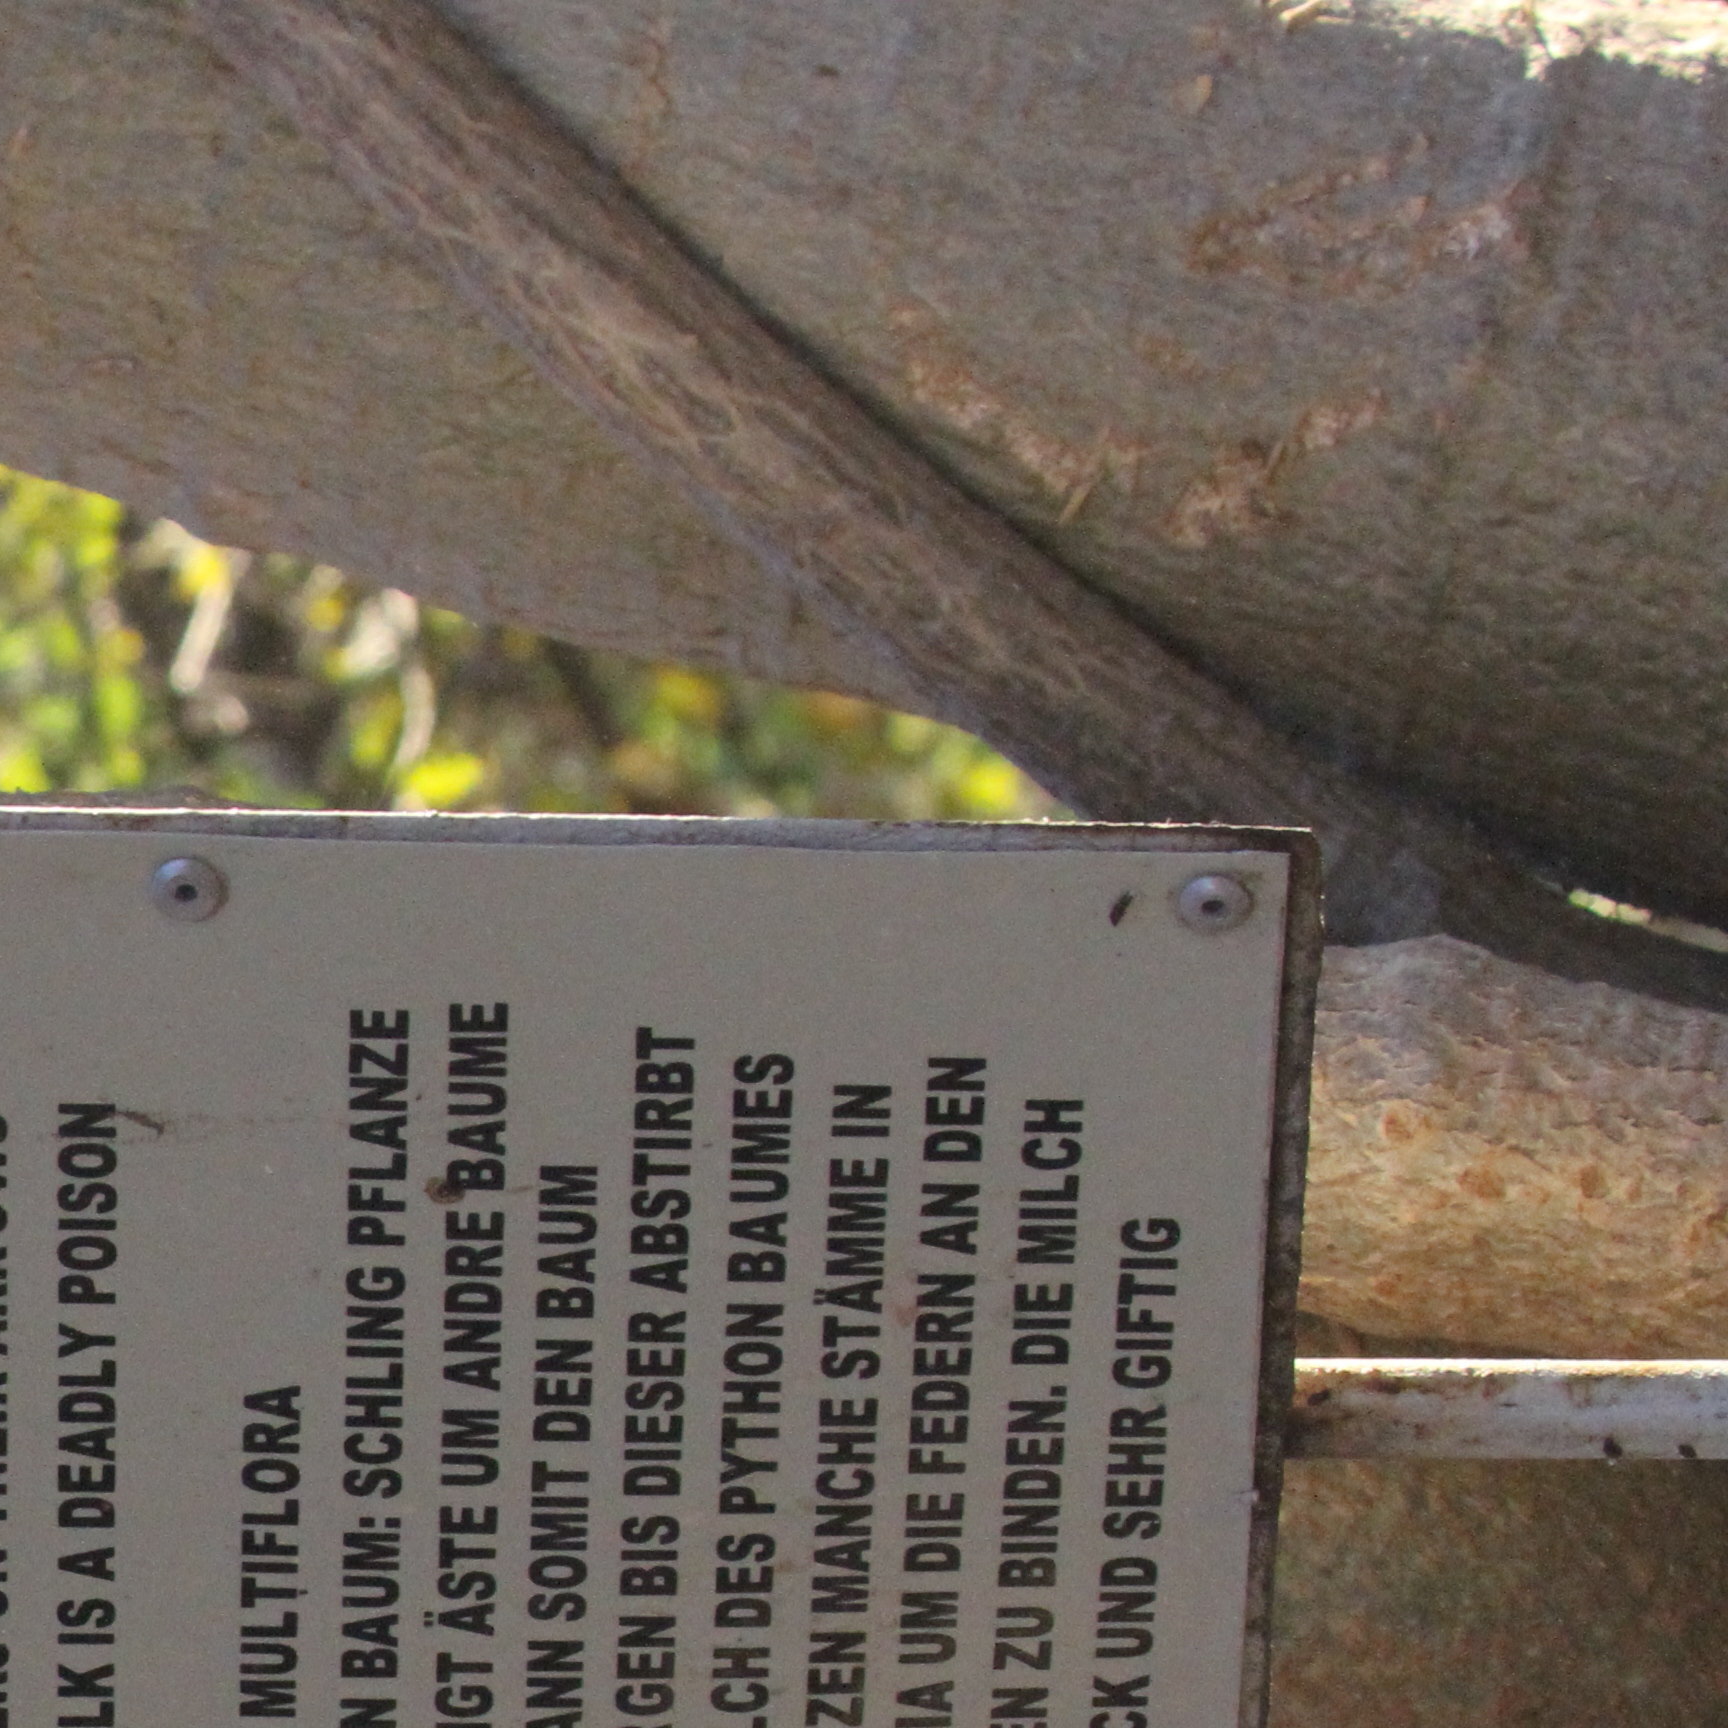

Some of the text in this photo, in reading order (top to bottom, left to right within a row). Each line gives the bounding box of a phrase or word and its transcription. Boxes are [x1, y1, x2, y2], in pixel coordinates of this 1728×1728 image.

[347, 1009, 410, 1247] PFLANZE
[446, 1002, 509, 1199] BAUME
[630, 1026, 695, 1293] ABSTIRBT
[727, 1053, 795, 1283] BAUMES
[831, 1084, 892, 1138] IN
[923, 1057, 987, 1162] DEN
[57, 1103, 118, 1305] POISON
[536, 1165, 598, 1319] BAUM
[920, 1183, 980, 1255] AN
[1016, 1099, 1084, 1264] MILCH
[443, 1211, 504, 1391] ANDRE
[814, 1158, 889, 1379] STÄMME
[1011, 1283, 1073, 1365] DIE
[1112, 1218, 1181, 1389] GIFTIG
[57, 1323, 117, 1529] DEADLY
[342, 1266, 406, 1499] SCHLING
[441, 1409, 499, 1486] UM
[533, 1339, 593, 1442] DEN
[623, 1311, 686, 1496] DIESER
[719, 1304, 783, 1514] PYTHON
[908, 1274, 975, 1474] FEDERN
[239, 1385, 301, 1718] MULTIFLORA
[528, 1461, 588, 1621] SOMIT
[811, 1398, 878, 1613] MANCHE
[904, 1493, 964, 1572] DIE
[998, 1386, 1067, 1587] BINDEN.
[1102, 1405, 1166, 1539] SEHR
[56, 1598, 116, 1645] IS
[57, 1547, 115, 1582] A
[341, 1517, 401, 1678] BAUM:
[424, 1506, 498, 1636] ÄSTE
[620, 1515, 680, 1596] BIS
[715, 1533, 775, 1628] DES
[899, 1592, 958, 1664] UM
[1095, 1557, 1157, 1658] UND
[993, 1607, 1053, 1670] ZU
